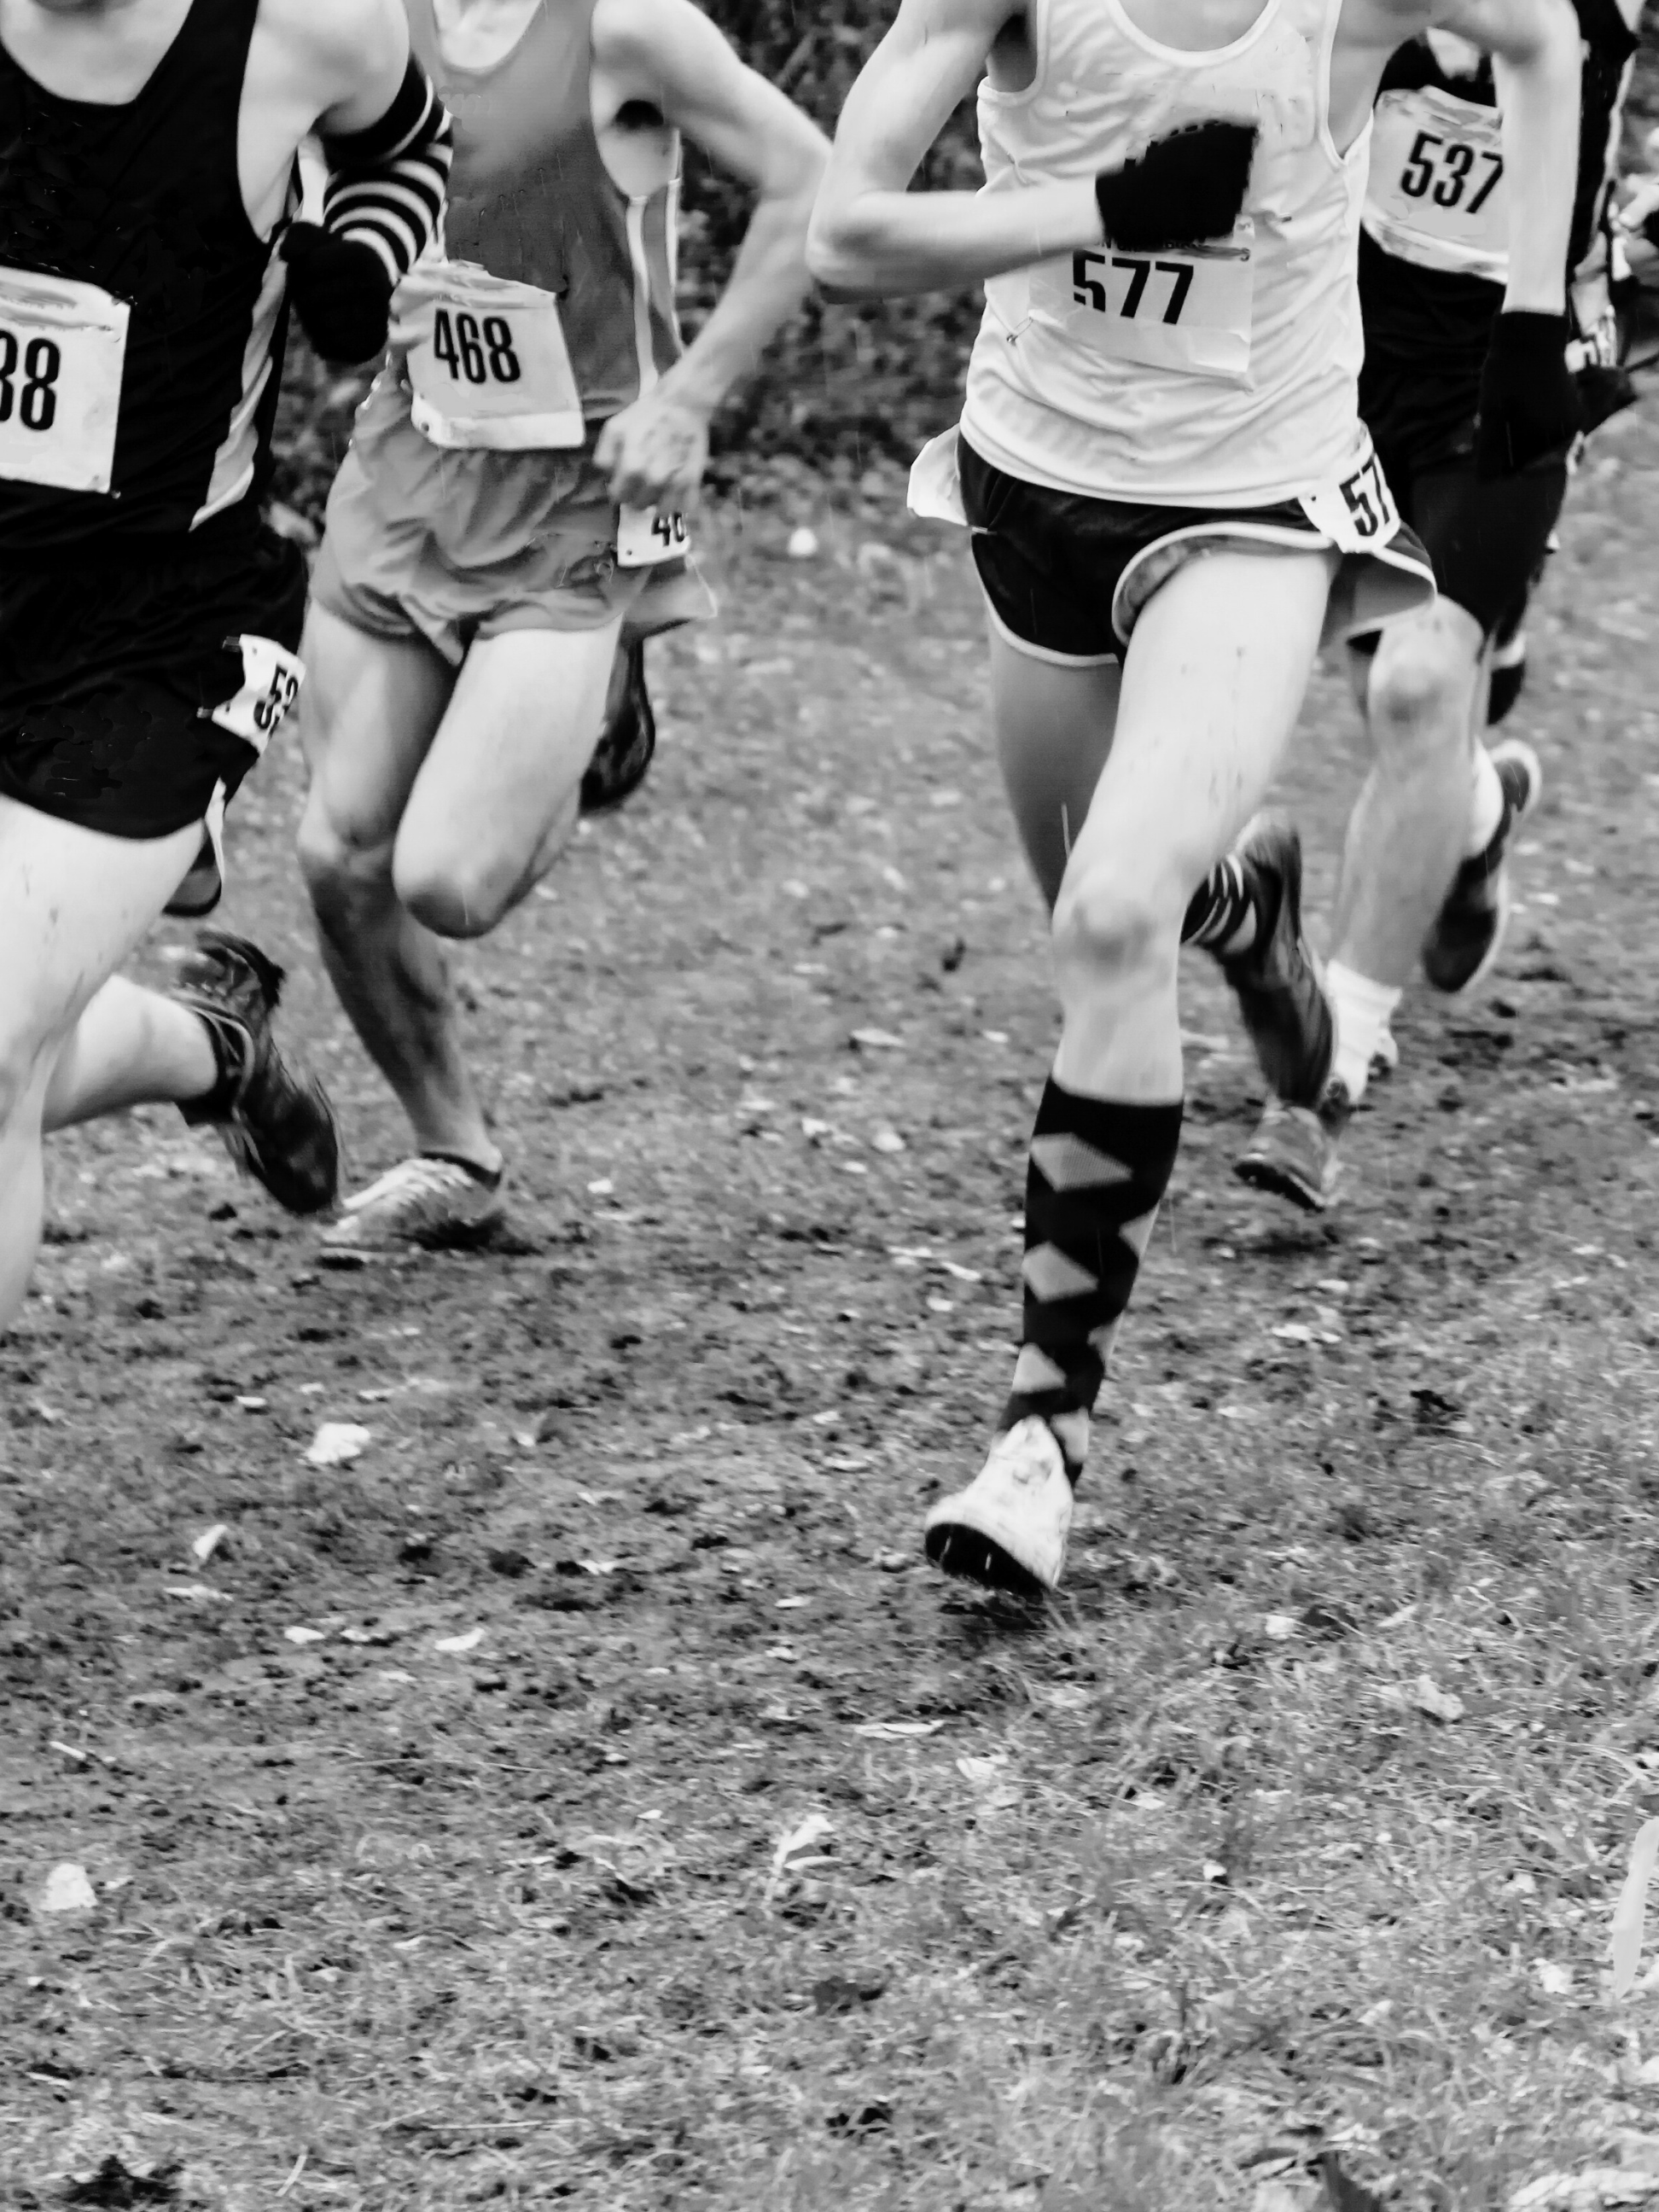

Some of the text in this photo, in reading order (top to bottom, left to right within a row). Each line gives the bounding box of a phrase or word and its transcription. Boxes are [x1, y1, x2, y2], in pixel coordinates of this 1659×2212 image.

[1400, 130, 1504, 214] 537
[1073, 249, 1194, 325] 577
[434, 308, 521, 384] 468
[1339, 456, 1390, 537] 57
